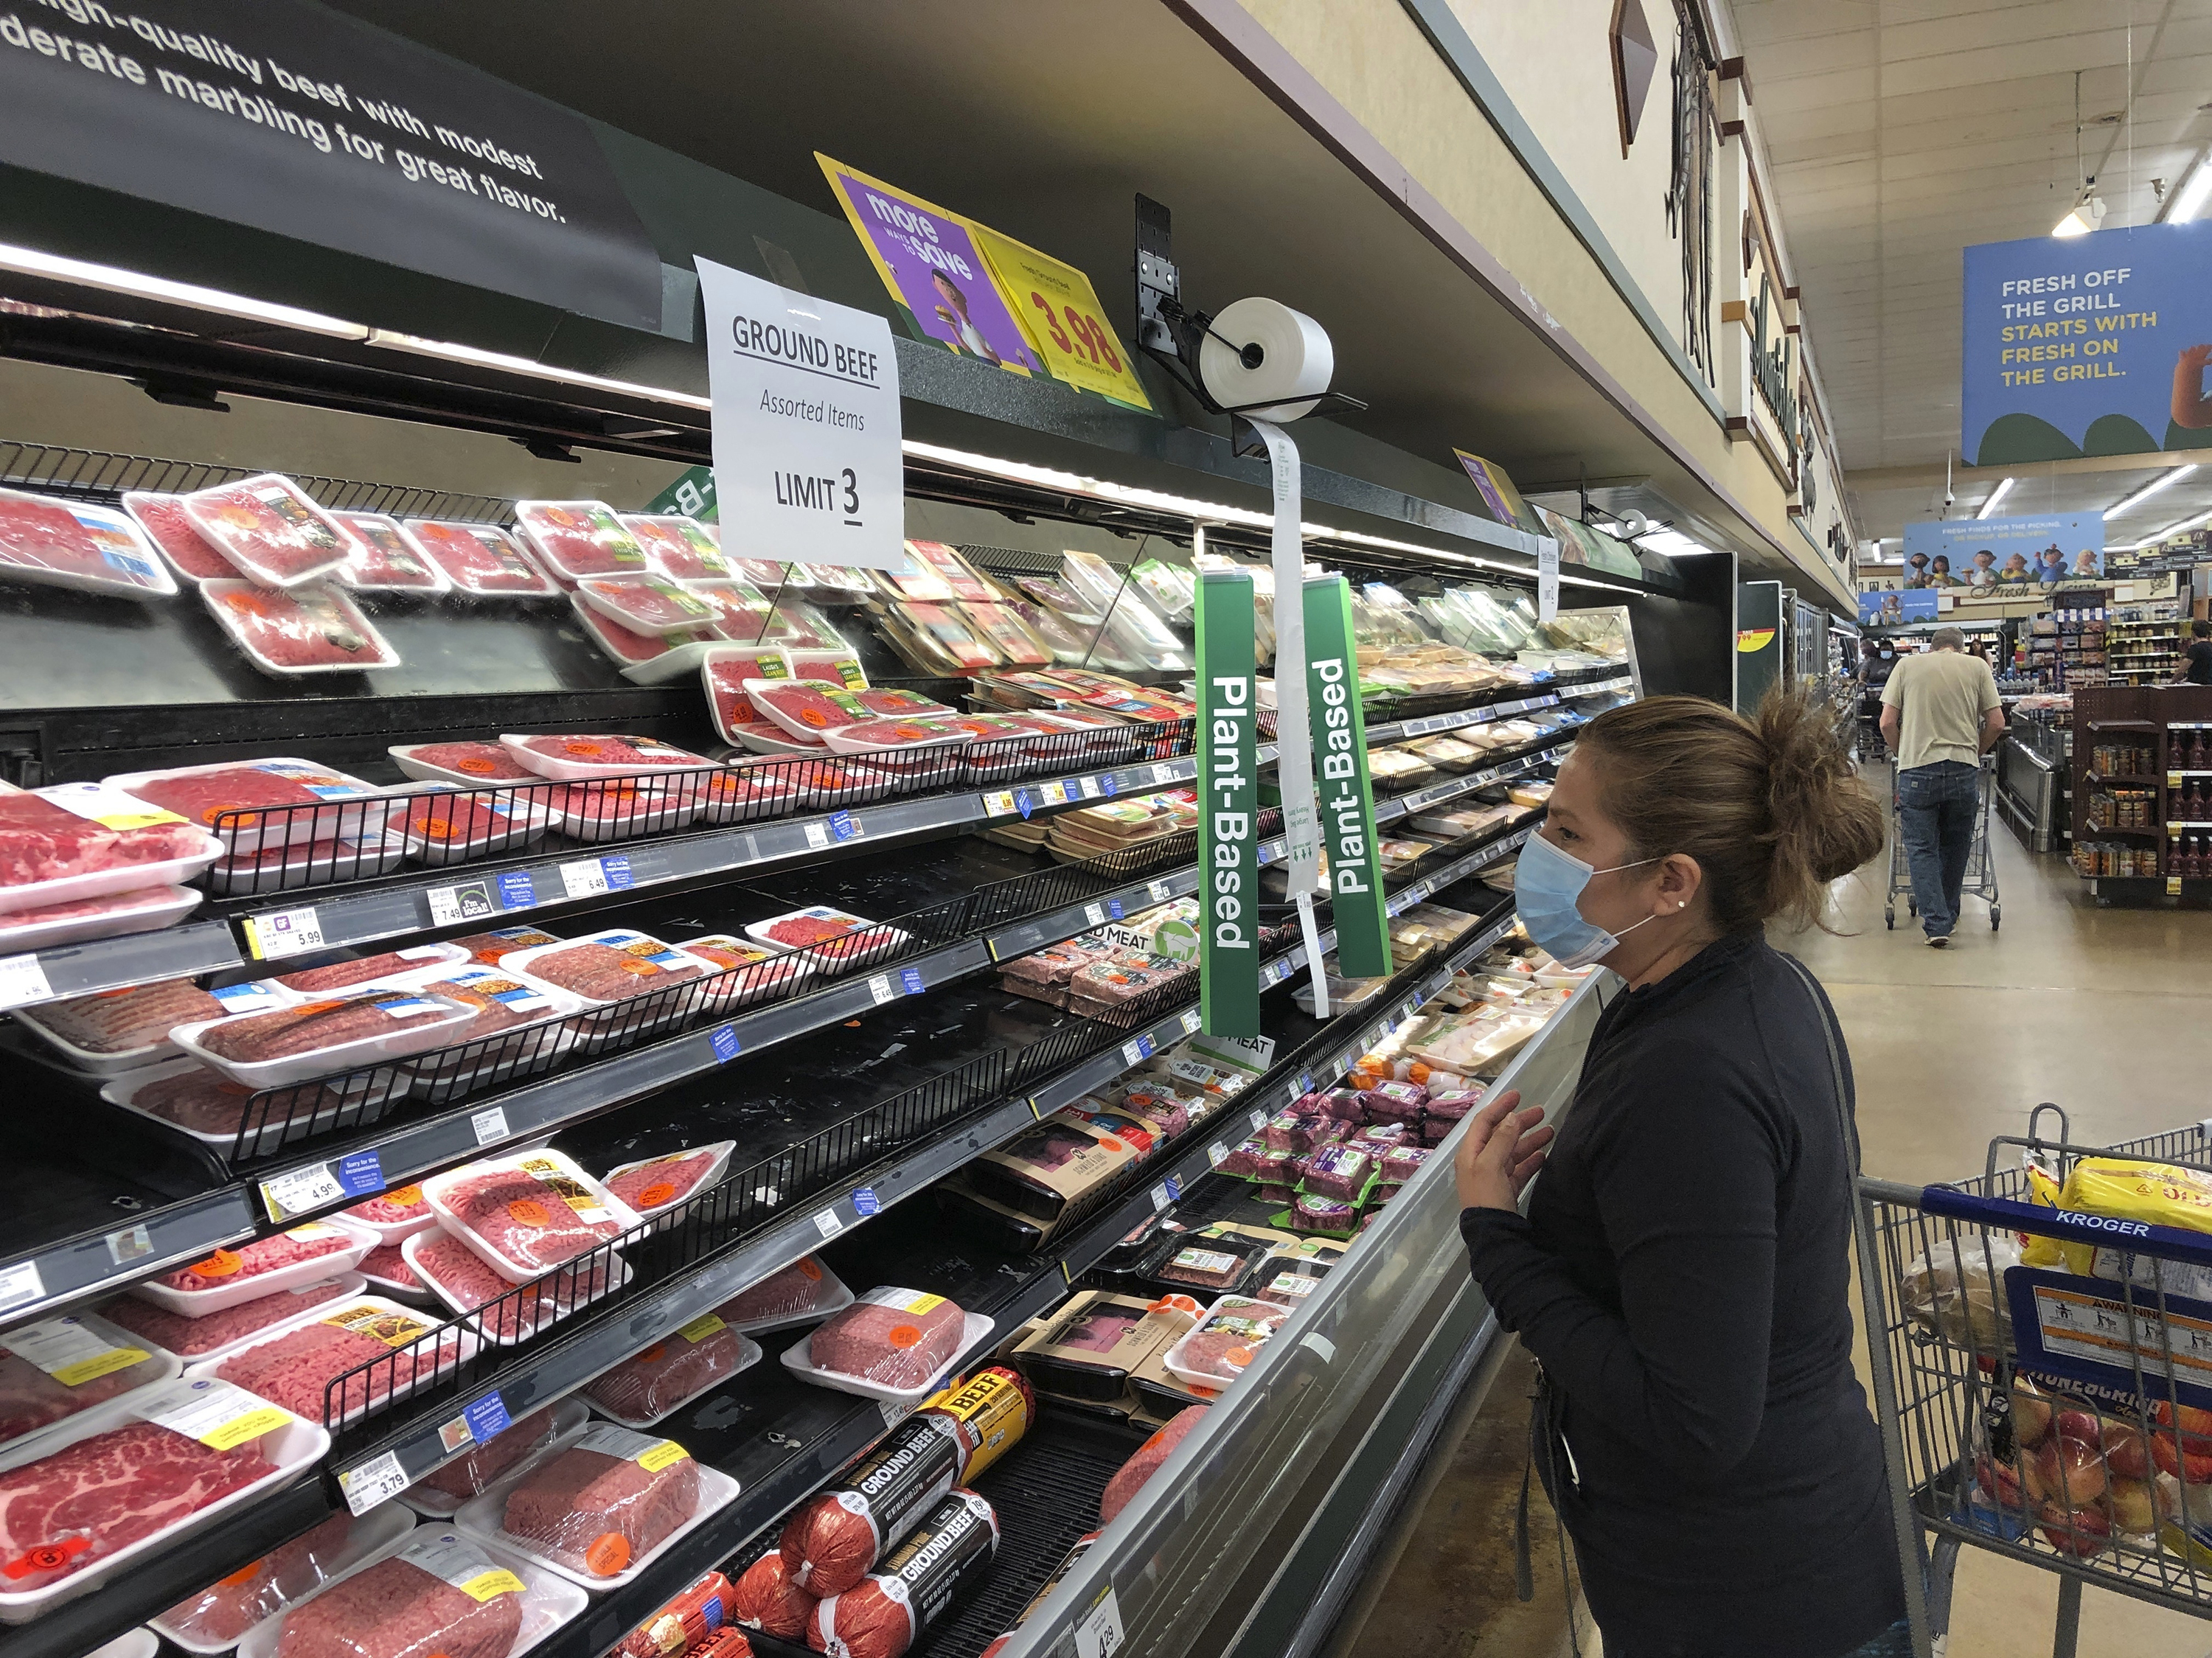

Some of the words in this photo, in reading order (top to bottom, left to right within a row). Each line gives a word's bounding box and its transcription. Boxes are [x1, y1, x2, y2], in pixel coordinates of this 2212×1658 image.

[37, 0, 263, 84] gh-quality
[267, 58, 352, 112] beef
[356, 97, 431, 140] with
[434, 125, 543, 180] modest
[156, 67, 333, 153] marbling
[335, 123, 385, 164] for
[395, 149, 479, 195] great
[480, 173, 566, 223] flavor.
[865, 192, 939, 244] more
[883, 226, 910, 245] WAYS
[902, 243, 916, 256] TO
[909, 236, 973, 281] save
[2002, 274, 2076, 297] FRESH
[2084, 268, 2132, 288] OFF
[2001, 299, 2046, 319] THE
[2053, 293, 2121, 313] GRILL
[1031, 290, 1123, 374] 3.98
[2001, 318, 2087, 342] STARTS
[2094, 311, 2157, 332] WITH
[732, 316, 829, 368] GROUND
[834, 344, 879, 381] BEEF
[2001, 343, 2076, 365] FRESH
[2083, 338, 2118, 357] ON
[2001, 368, 2045, 387] THE
[2053, 361, 2126, 382] GRILL.
[760, 389, 824, 422] Assorted
[828, 403, 865, 431] Items
[774, 470, 835, 511] LIMIT
[842, 467, 860, 515] 3
[1970, 581, 2030, 599] Fresh
[1312, 658, 1368, 894] Plant-Based
[1213, 676, 1250, 950] Plant-Based
[588, 878, 605, 889] 6.49
[442, 908, 461, 921] 7.49
[462, 902, 490, 916] local!
[464, 899, 478, 909] I'm
[276, 918, 288, 929] GF
[299, 930, 321, 945] 5.99
[1106, 929, 1149, 950] MEAT
[347, 1161, 360, 1169] Sorry
[312, 1182, 336, 1200] 4.99
[2055, 1210, 2151, 1238] KROGER
[2099, 1299, 2163, 1320] WANIN
[949, 1374, 1001, 1410] BEEF
[473, 1405, 484, 1414] Sorry
[860, 1449, 914, 1494] GROUND
[906, 1427, 936, 1454] BEEF
[380, 1473, 405, 1494] 3.79
[901, 1531, 953, 1581] GROUND
[948, 1511, 974, 1539] BEEF
[598, 1551, 619, 1570] SPECIAL
